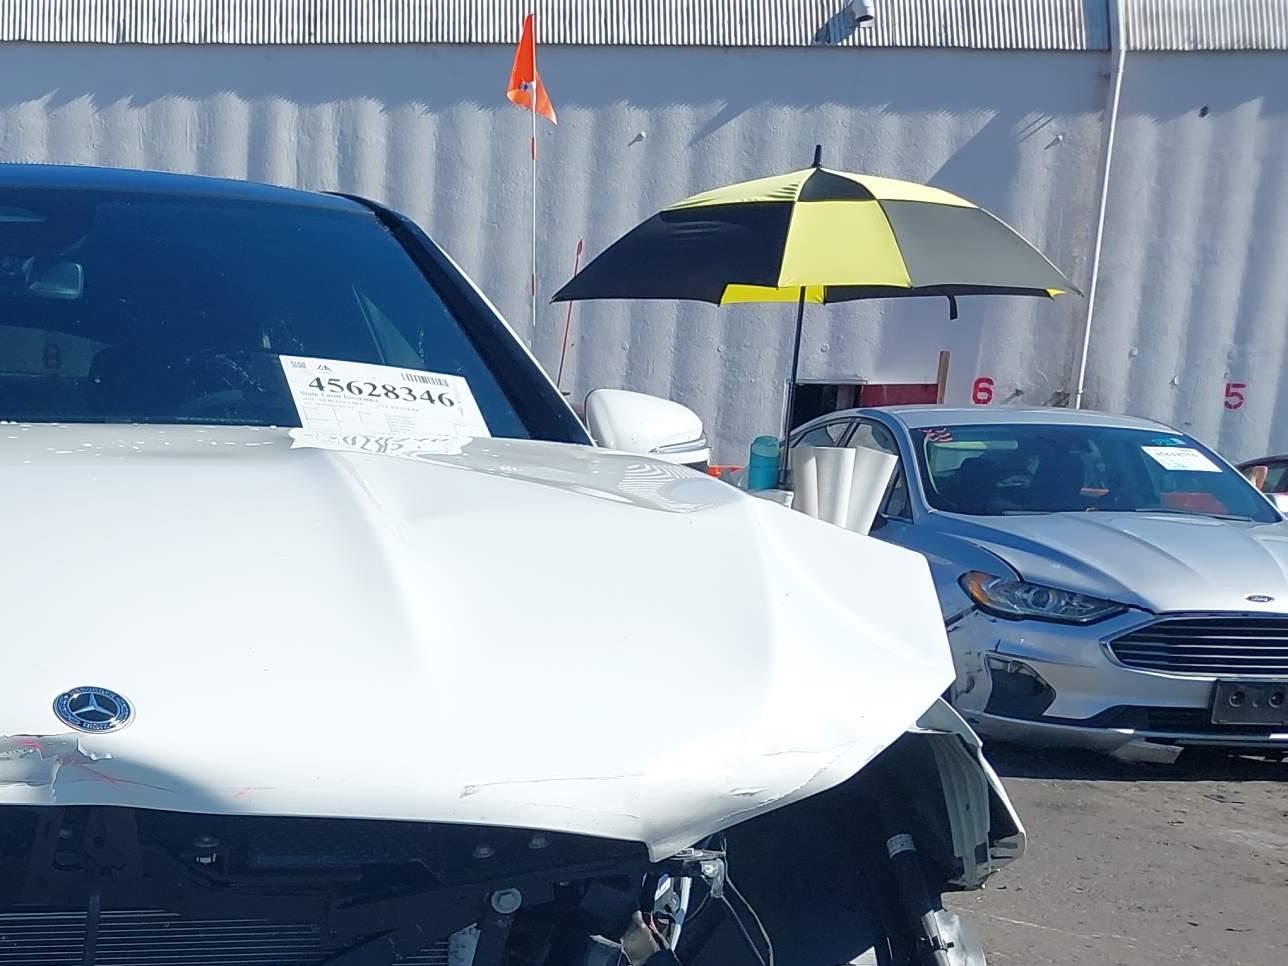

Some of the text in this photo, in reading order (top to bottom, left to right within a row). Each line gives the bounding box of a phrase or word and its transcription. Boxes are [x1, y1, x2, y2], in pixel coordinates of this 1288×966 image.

[308, 376, 456, 408] 45628346
[972, 377, 994, 405] 6
[1223, 383, 1246, 410] 5
